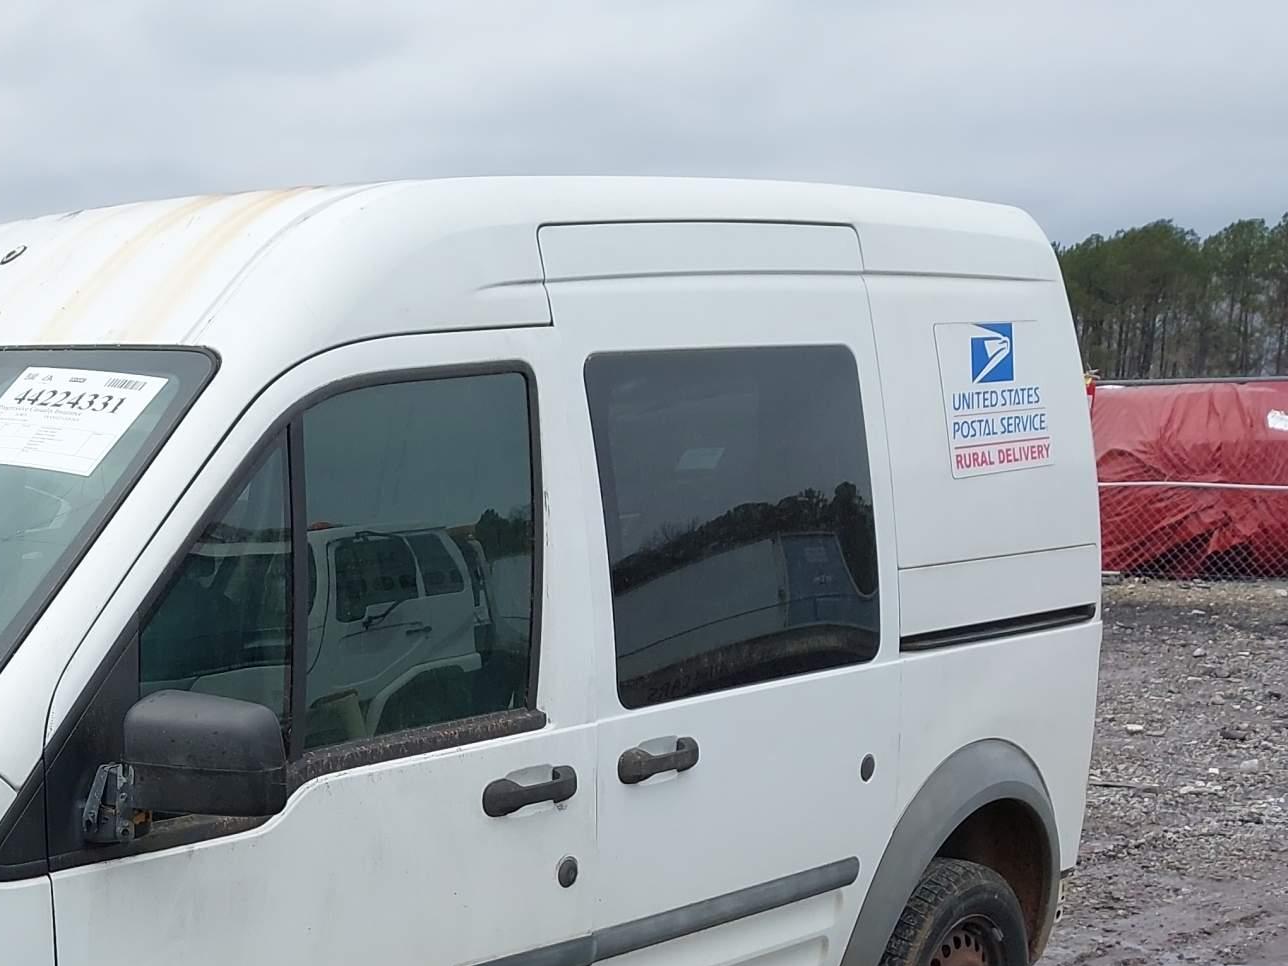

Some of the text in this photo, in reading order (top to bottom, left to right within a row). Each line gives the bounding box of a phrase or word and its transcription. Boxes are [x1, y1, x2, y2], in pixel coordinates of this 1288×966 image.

[14, 388, 127, 414] 44224331
[952, 386, 1040, 411] UNITED STATES
[952, 413, 1046, 440] POSTAL SERVICE
[955, 443, 1051, 470] RURAL DELIVERY
